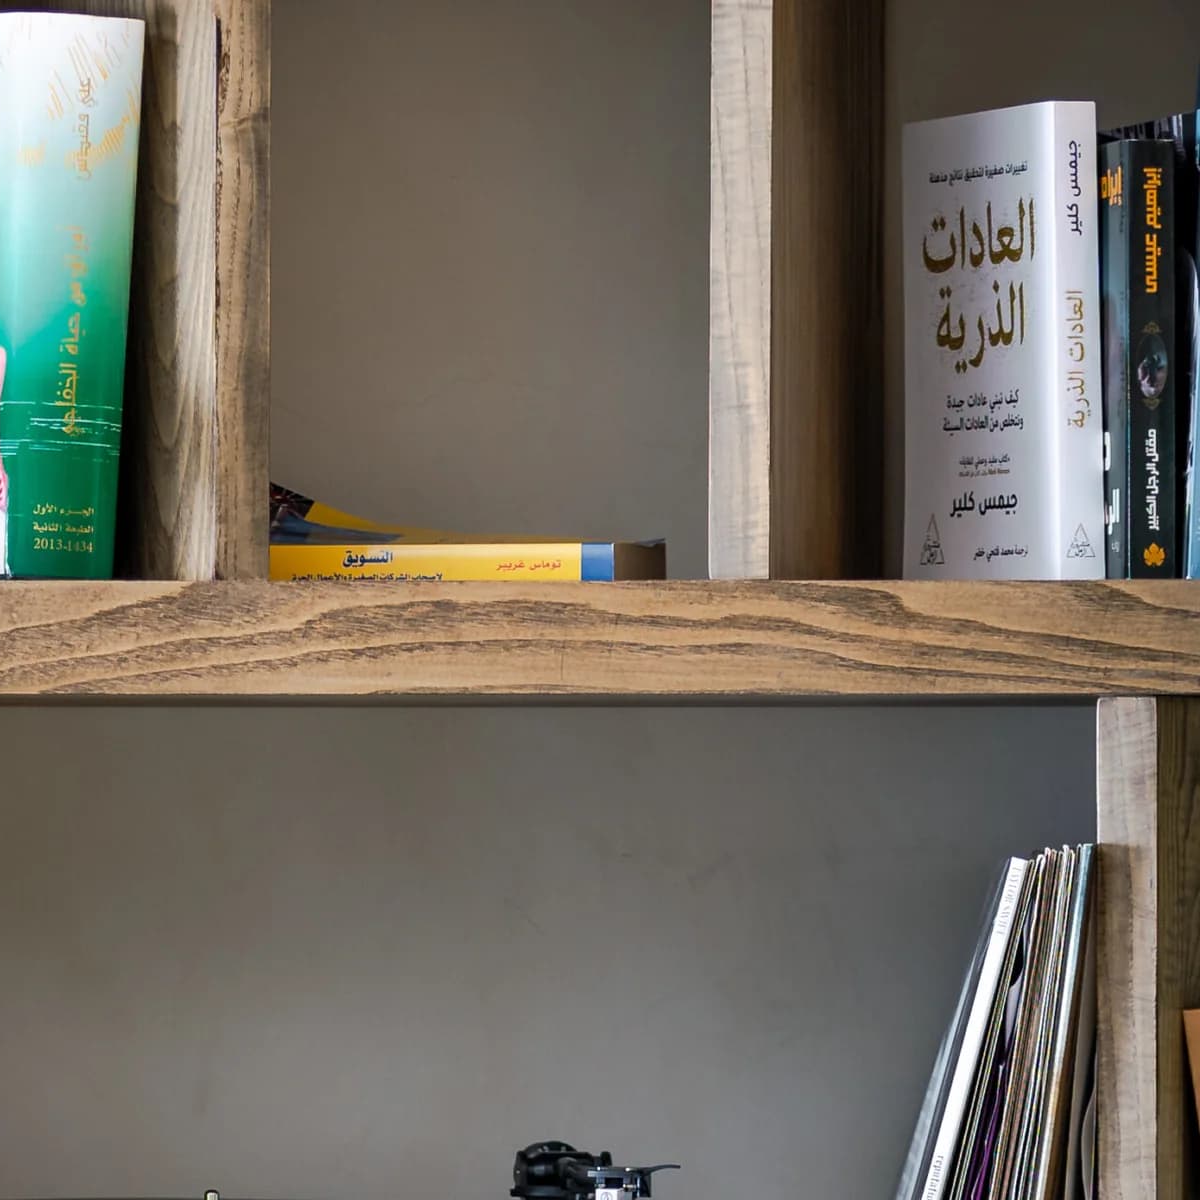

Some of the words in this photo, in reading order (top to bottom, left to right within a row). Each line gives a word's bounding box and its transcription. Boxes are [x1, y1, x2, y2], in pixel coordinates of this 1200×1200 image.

[1069, 141, 1081, 196] جيمس
[1143, 168, 1162, 229] إبراهيم
[922, 197, 1035, 274] العادات
[1067, 204, 1082, 236] كلير
[1146, 234, 1161, 293] عيسى
[71, 283, 87, 306] من
[61, 312, 82, 355] حياة
[936, 279, 1025, 375] الذرية
[1067, 291, 1085, 362] العادات
[55, 362, 78, 437] الخفاجي
[946, 395, 965, 413] جيدة
[967, 392, 987, 408] عادات
[1005, 389, 1020, 408] كيف
[1067, 372, 1091, 428] الذرية
[965, 415, 989, 431] العادات
[989, 418, 999, 432] من
[1145, 428, 1159, 462] مقتل
[1146, 463, 1160, 495] الرجل
[950, 491, 975, 518] كلير
[978, 492, 1019, 515] جيمس
[1146, 495, 1160, 531] الكبير
[343, 550, 393, 567] التسويق
